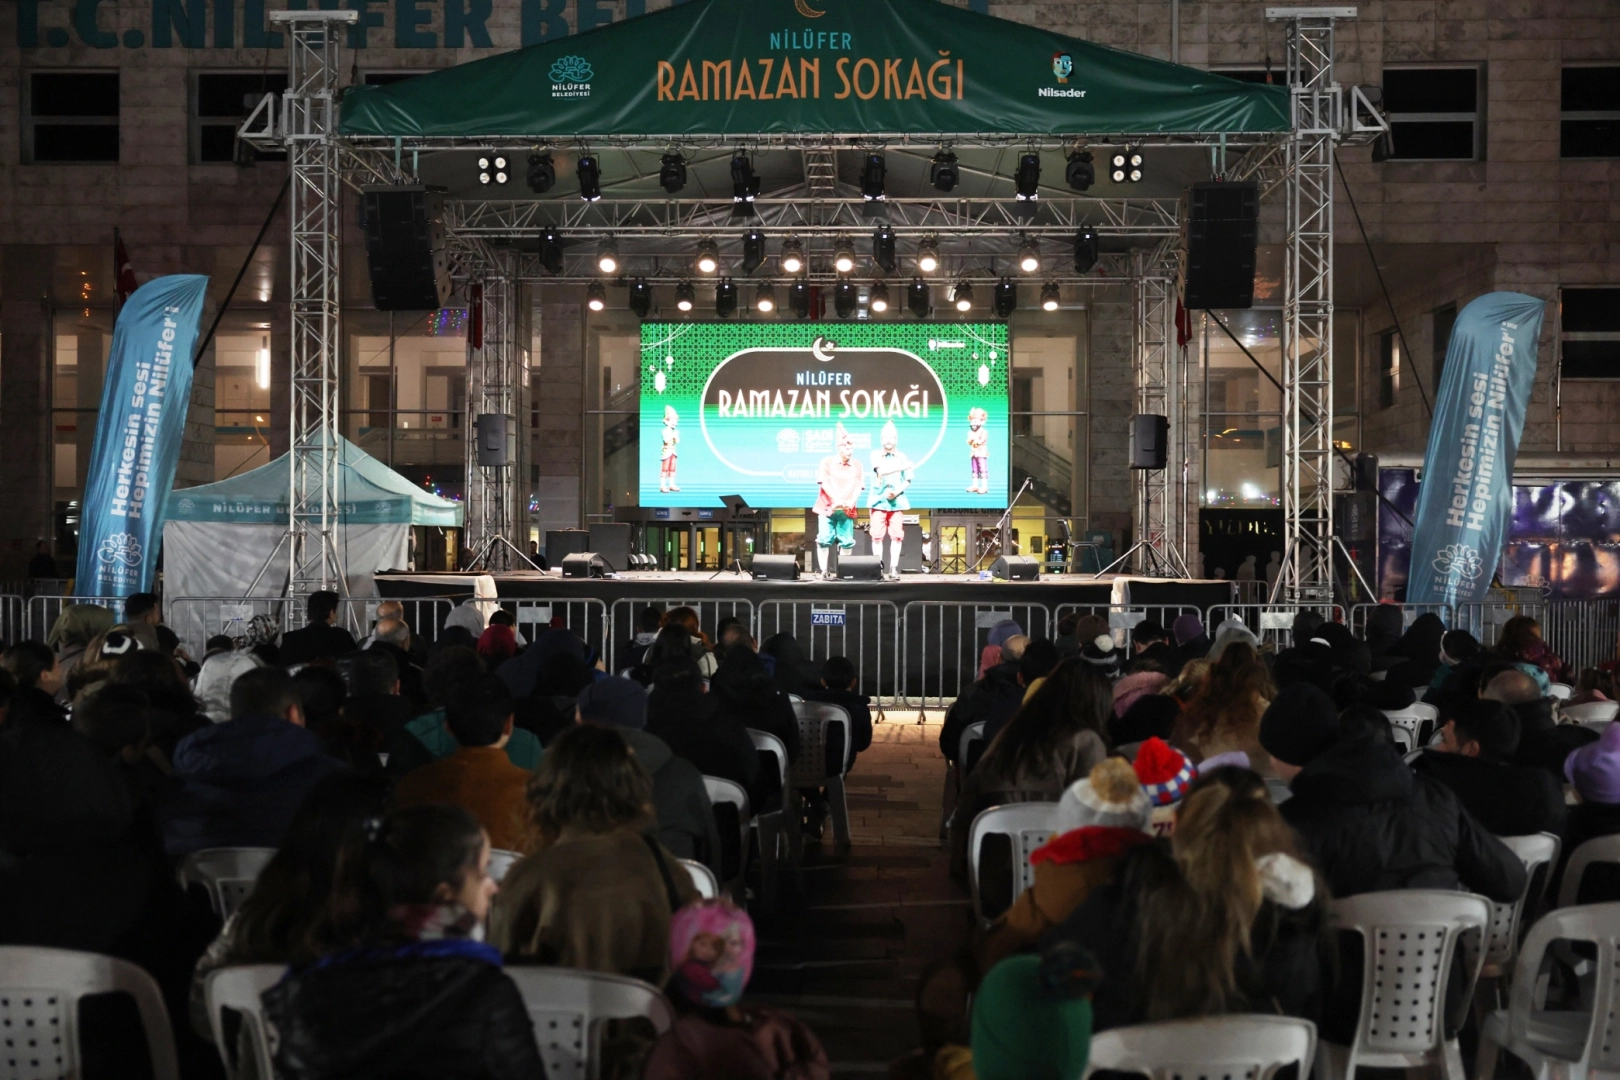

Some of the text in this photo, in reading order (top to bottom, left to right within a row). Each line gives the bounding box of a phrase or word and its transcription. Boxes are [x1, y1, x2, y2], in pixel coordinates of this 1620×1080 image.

[769, 31, 852, 50] NİLÜFER
[657, 49, 964, 101] RAMAZAN SOKAĞI
[552, 83, 591, 91] NİLÜFER
[1038, 87, 1086, 98] Nilsader
[796, 371, 852, 386] NİLÜFER
[718, 384, 929, 418] RAMAZAN SOKAĞI
[128, 306, 179, 519] Hepimizin Nilüfer'i
[1467, 321, 1518, 531] Hepimizin Nilüfer'i
[111, 362, 151, 516] Herkesin sesi
[1446, 372, 1489, 527] Herkesin sesi
[213, 501, 271, 513] NİLÜFER
[99, 565, 139, 577] NİLÜFER
[1434, 575, 1477, 590] NİLÜFER
[813, 614, 844, 624] ZABITA
